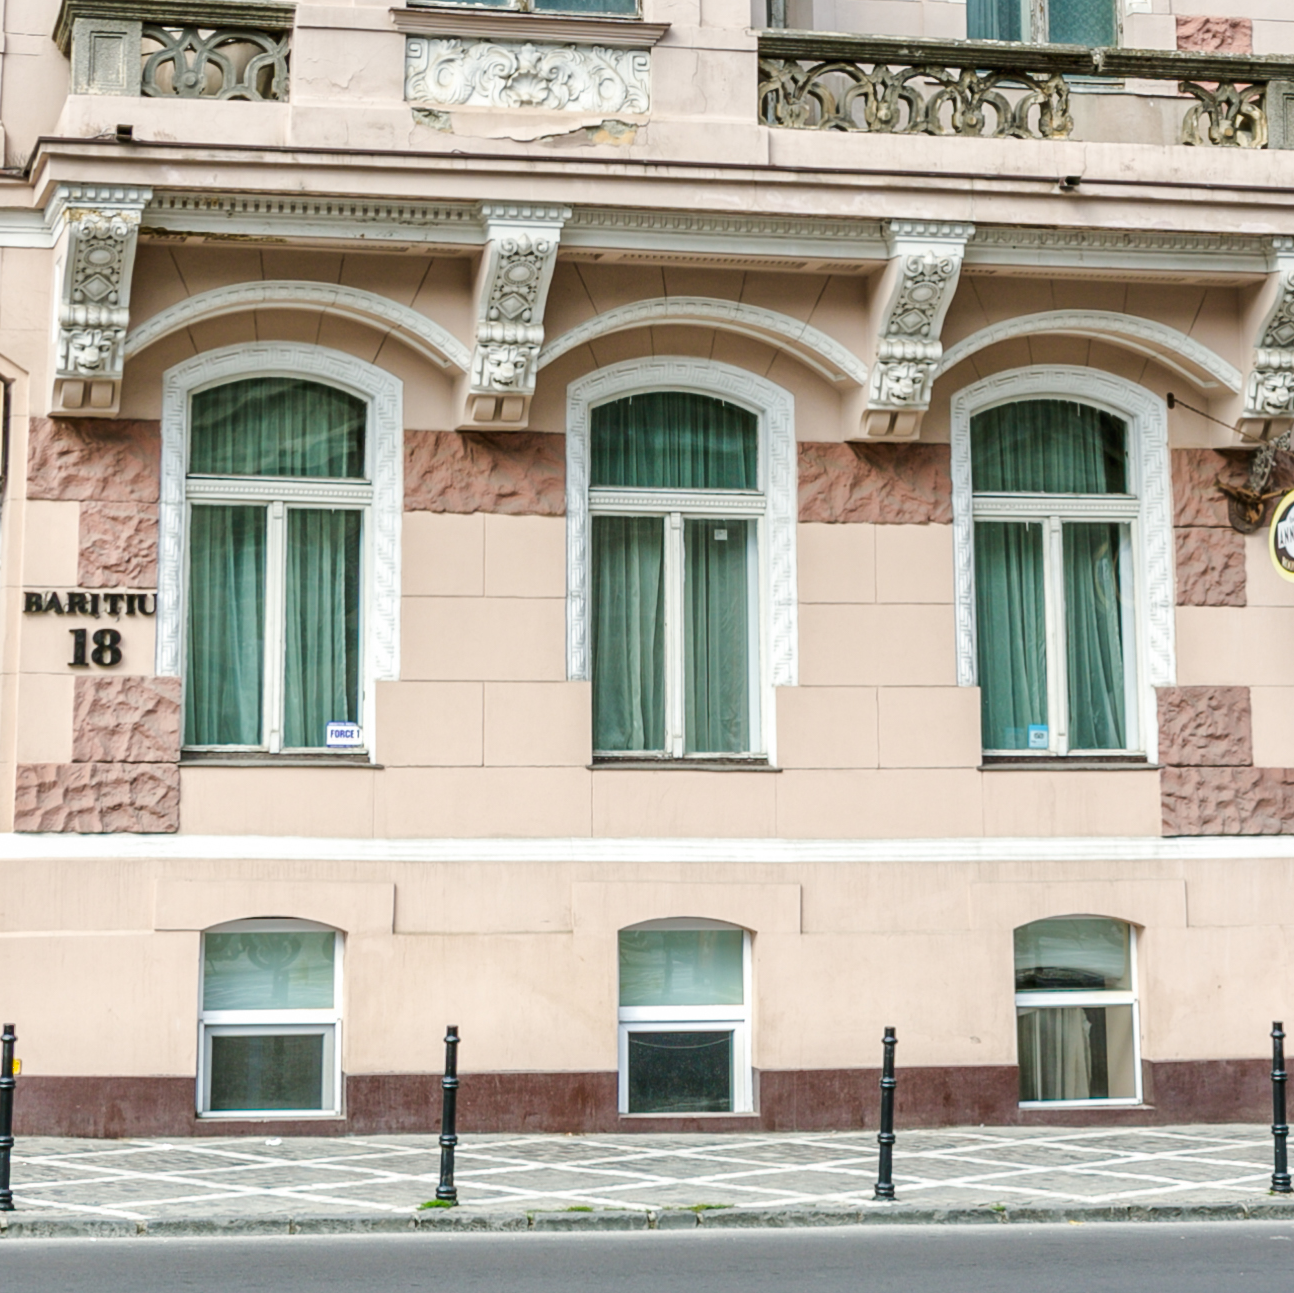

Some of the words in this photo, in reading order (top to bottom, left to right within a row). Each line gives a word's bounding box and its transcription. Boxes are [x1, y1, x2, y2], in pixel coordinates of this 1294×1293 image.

[67, 628, 122, 666] 18
[330, 729, 354, 738] FORCE
[356, 729, 360, 738] 1
